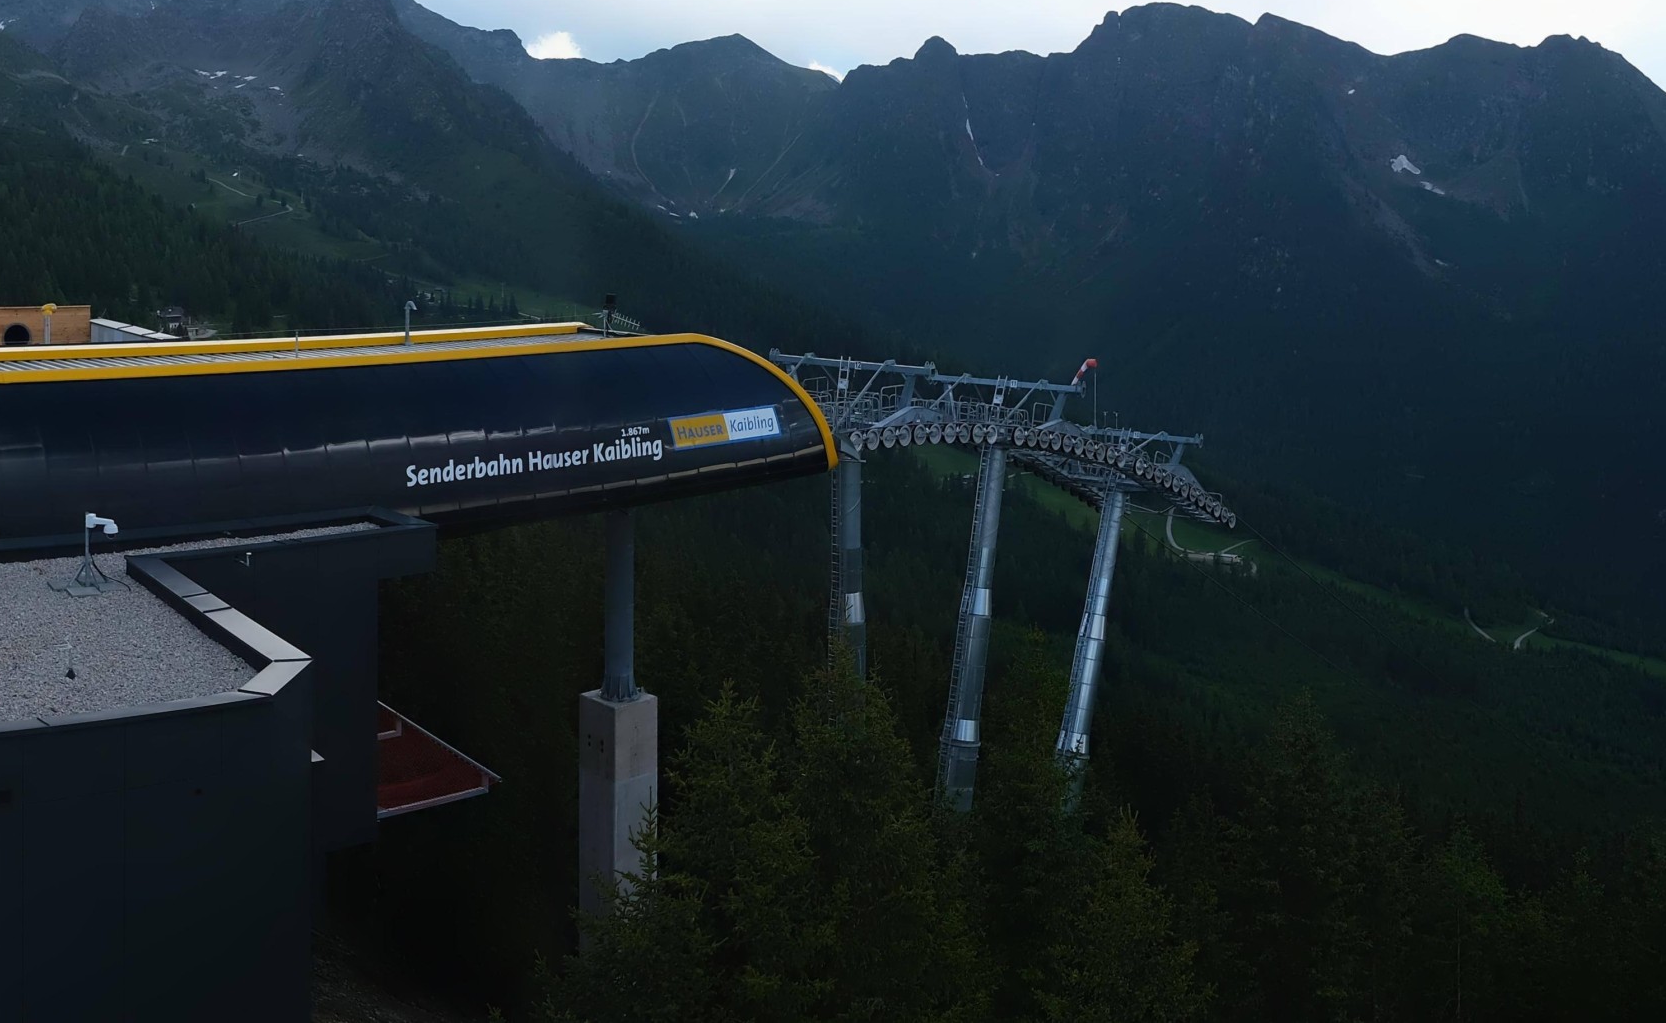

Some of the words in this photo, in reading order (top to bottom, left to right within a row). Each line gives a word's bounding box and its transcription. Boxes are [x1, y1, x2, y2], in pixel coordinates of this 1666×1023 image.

[621, 427, 650, 437] 1.867m
[677, 424, 724, 440] HAUSER
[730, 417, 774, 432] Kaibling
[406, 453, 523, 487] Senderbahn
[528, 448, 589, 471] Hauser
[593, 436, 663, 464] Kaibling
